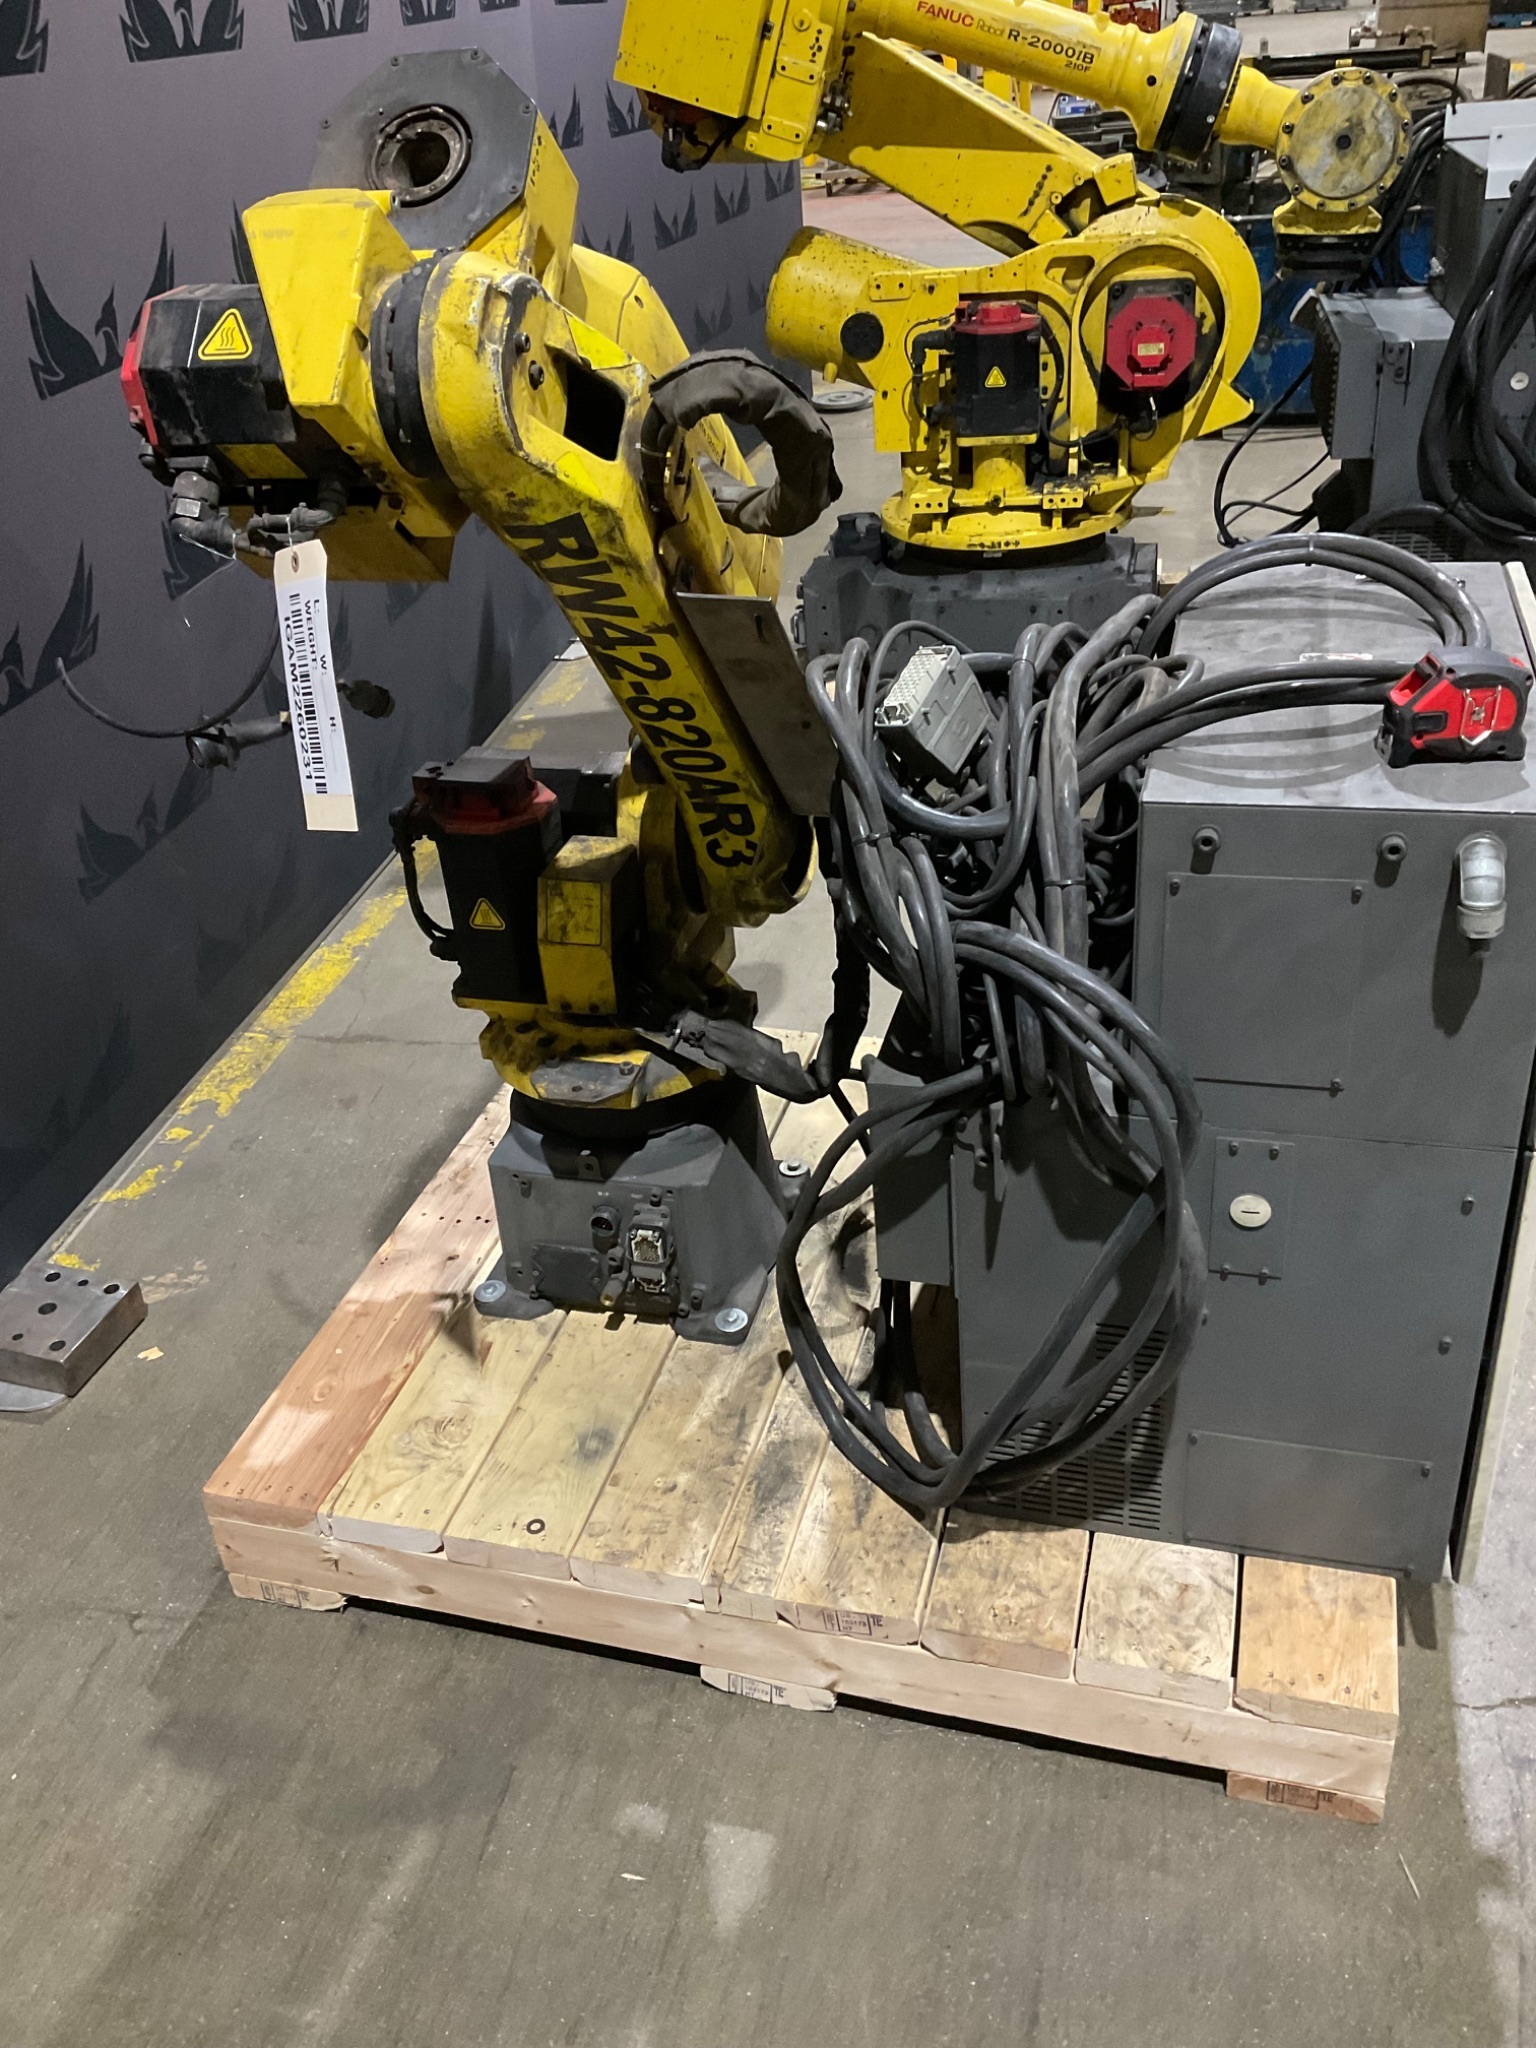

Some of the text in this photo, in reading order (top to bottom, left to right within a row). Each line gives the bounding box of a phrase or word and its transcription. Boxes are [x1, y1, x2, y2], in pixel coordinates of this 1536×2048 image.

[916, 1, 975, 28] FANUC
[976, 18, 1005, 37] Robot
[1064, 60, 1092, 73] 210F
[304, 599, 318, 670] WEIGHT:
[313, 599, 337, 733] L: W: H:
[284, 616, 313, 780] IGAM2260231
[505, 512, 758, 869] RW42-820AR3
